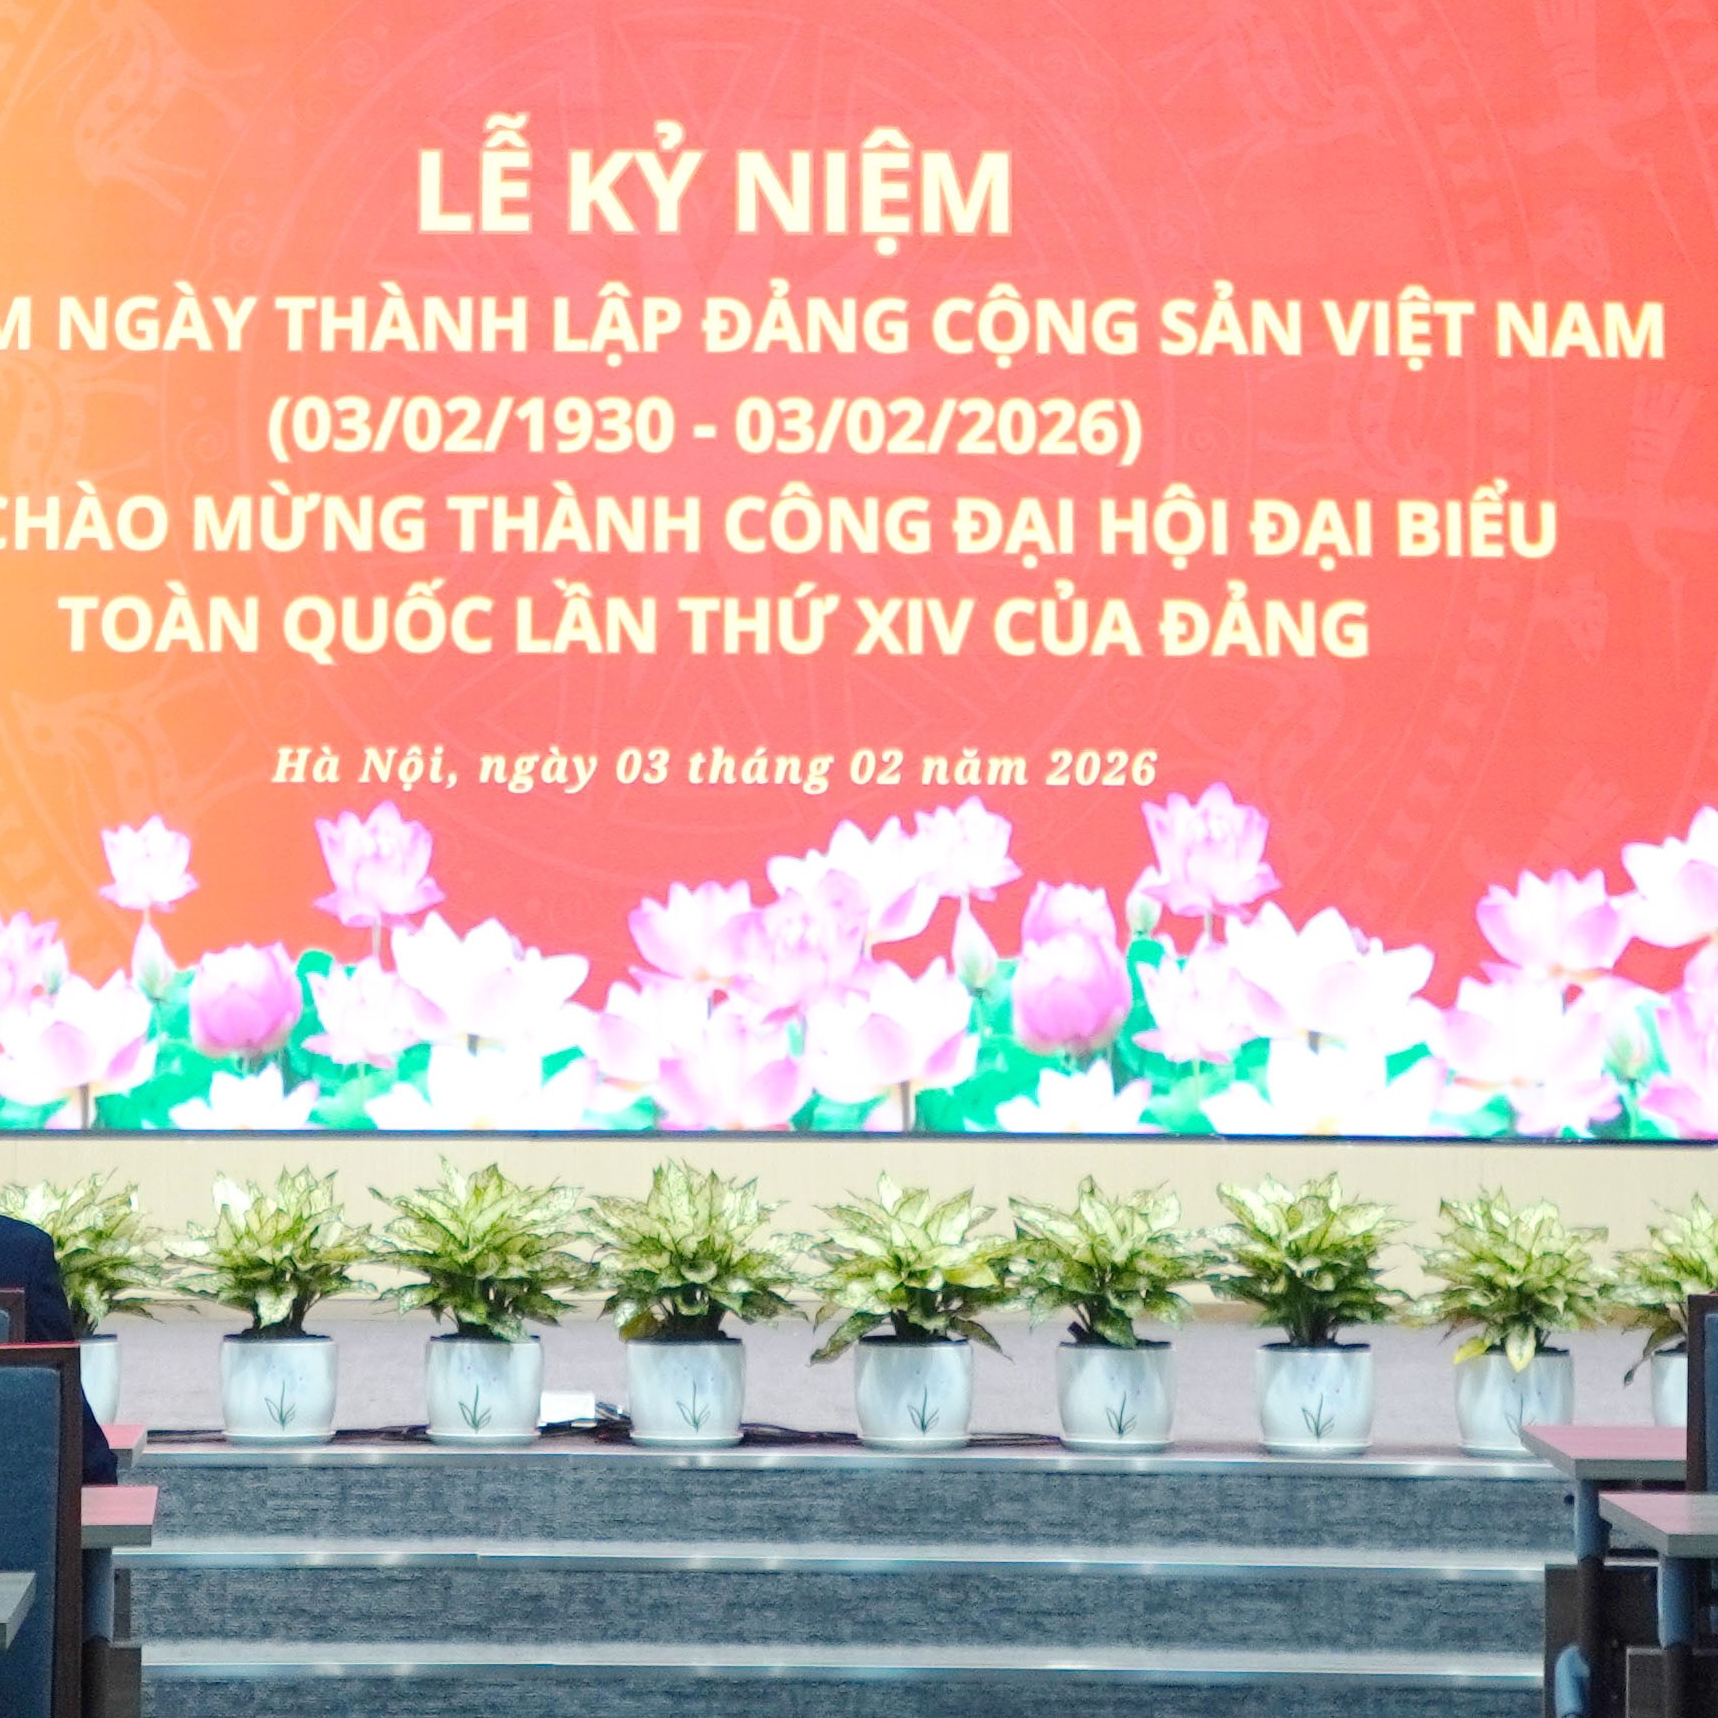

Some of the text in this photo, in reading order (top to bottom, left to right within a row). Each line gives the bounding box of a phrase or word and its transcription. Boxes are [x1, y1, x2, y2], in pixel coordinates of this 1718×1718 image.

[420, 113, 1010, 256] LỄ KỶ NIỆM
[59, 281, 258, 351] NGÀY
[275, 282, 526, 352] THÀNH
[554, 282, 682, 367] LẬP
[701, 278, 908, 354] ĐẢNG
[933, 283, 1137, 369] CỘNG
[1161, 281, 1301, 355] SẢN
[1323, 286, 1475, 371] VIỆT
[1498, 302, 1663, 358] NAM
[269, 397, 674, 463] (03/02/1930
[736, 397, 1141, 466] 03/02/2026)
[194, 481, 425, 552] MỪNG
[447, 480, 700, 553] THÀNH
[726, 481, 930, 554] CÔNG
[953, 498, 1074, 569] ĐẠI
[1101, 484, 1227, 569] HỘI
[1250, 500, 1371, 570] ĐẠI
[1399, 479, 1555, 558] BIỂU
[58, 578, 1368, 665] TOÀN QUỐC LẦN THỨ XIV CỦA ĐẢNG
[271, 745, 1158, 795] Hà Nội, ngày 03 tháng 02 năm 2026
